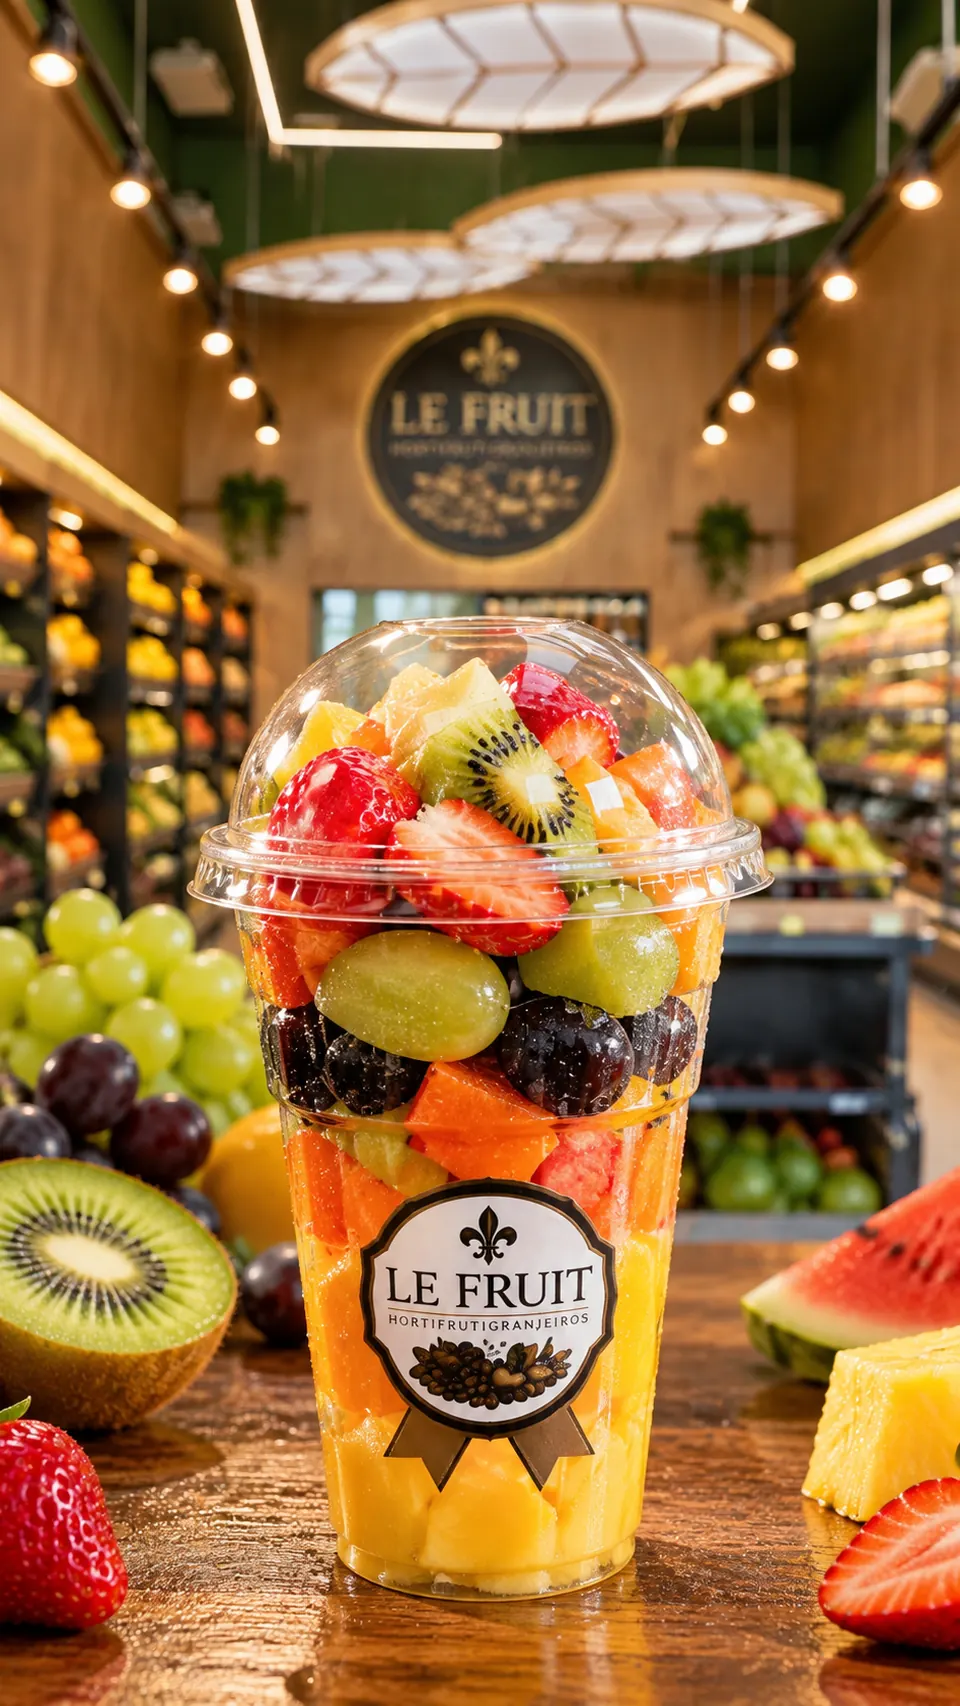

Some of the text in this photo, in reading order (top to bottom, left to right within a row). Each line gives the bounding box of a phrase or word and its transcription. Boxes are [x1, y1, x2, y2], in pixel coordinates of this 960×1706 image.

[391, 391, 598, 436] LE FRUIT
[385, 1265, 593, 1308] LE FRUIT
[388, 1312, 589, 1331] HORTIFRUTIGRANJEIROS
